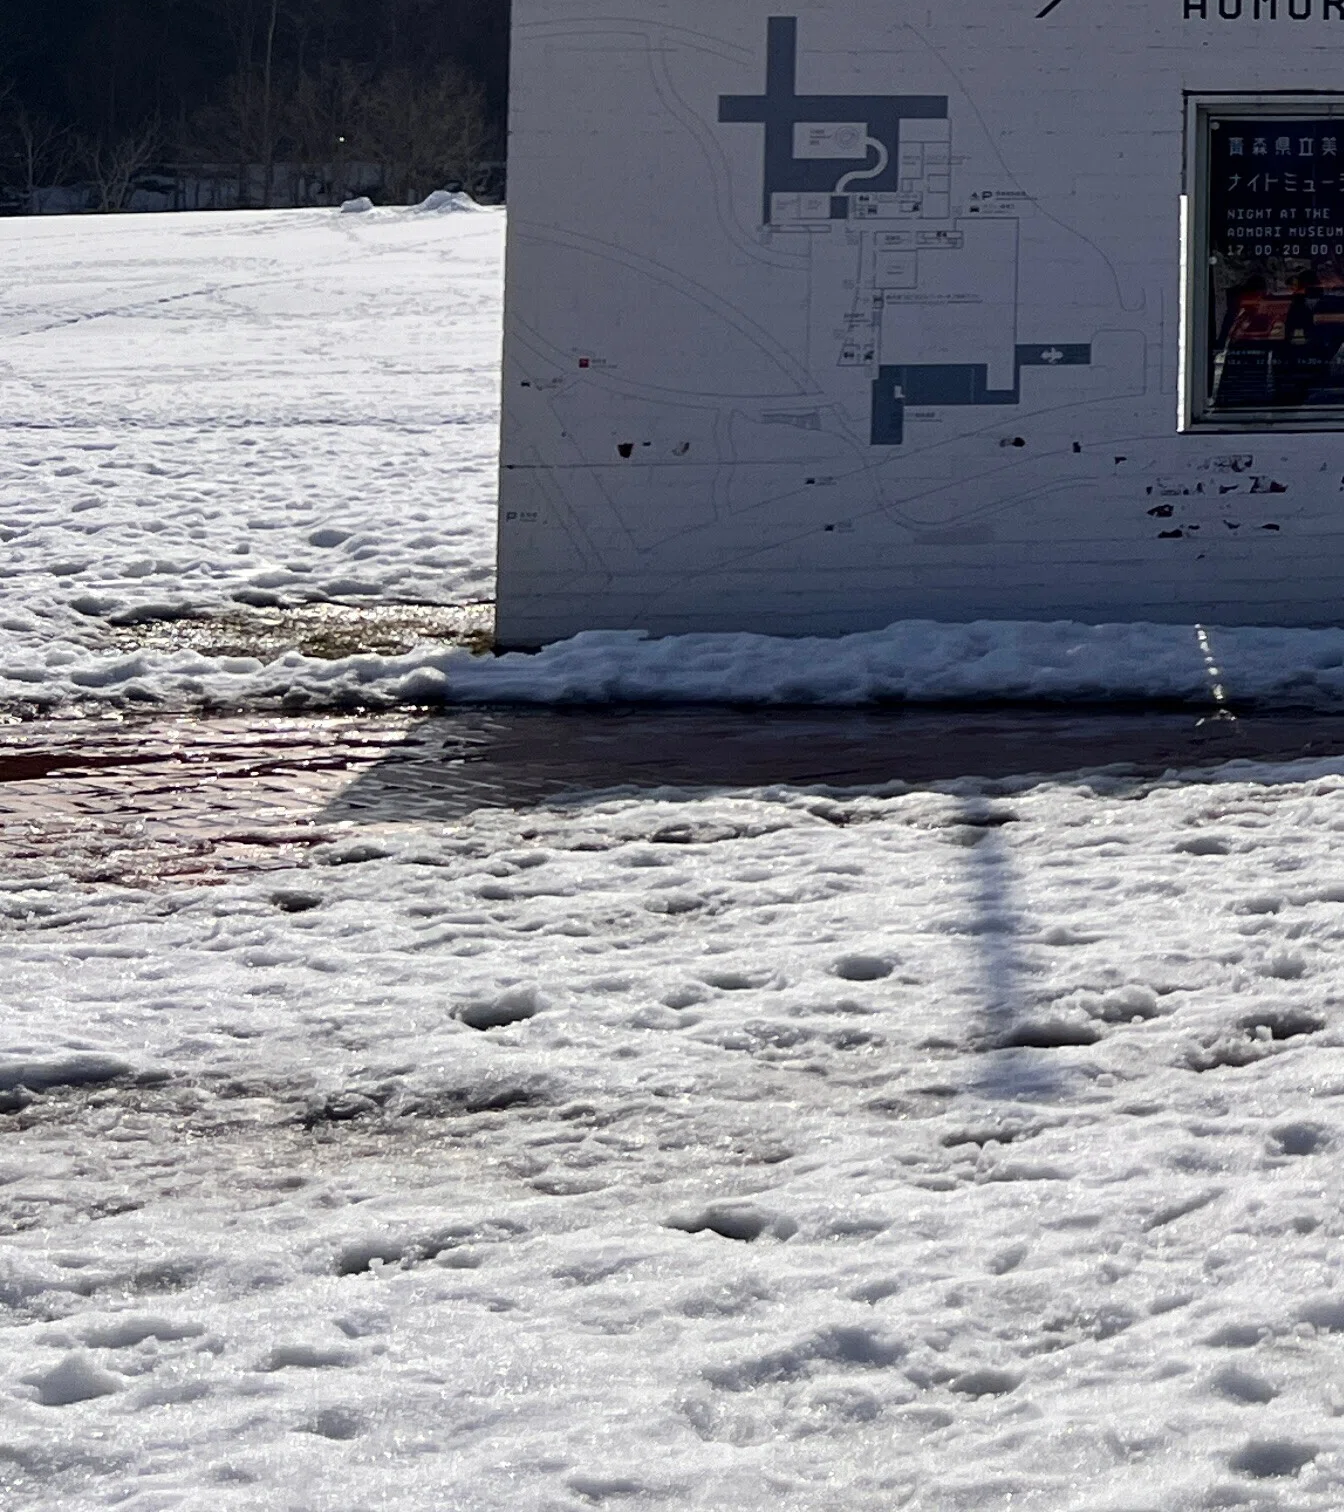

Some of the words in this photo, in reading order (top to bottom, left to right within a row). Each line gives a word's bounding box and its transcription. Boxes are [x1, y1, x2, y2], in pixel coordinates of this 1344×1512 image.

[1227, 208, 1273, 219] NIGHT
[1279, 208, 1297, 219] AT
[1304, 208, 1331, 219] THE
[1227, 226, 1282, 237] AOMORI
[1288, 226, 1344, 237] MUSEUM
